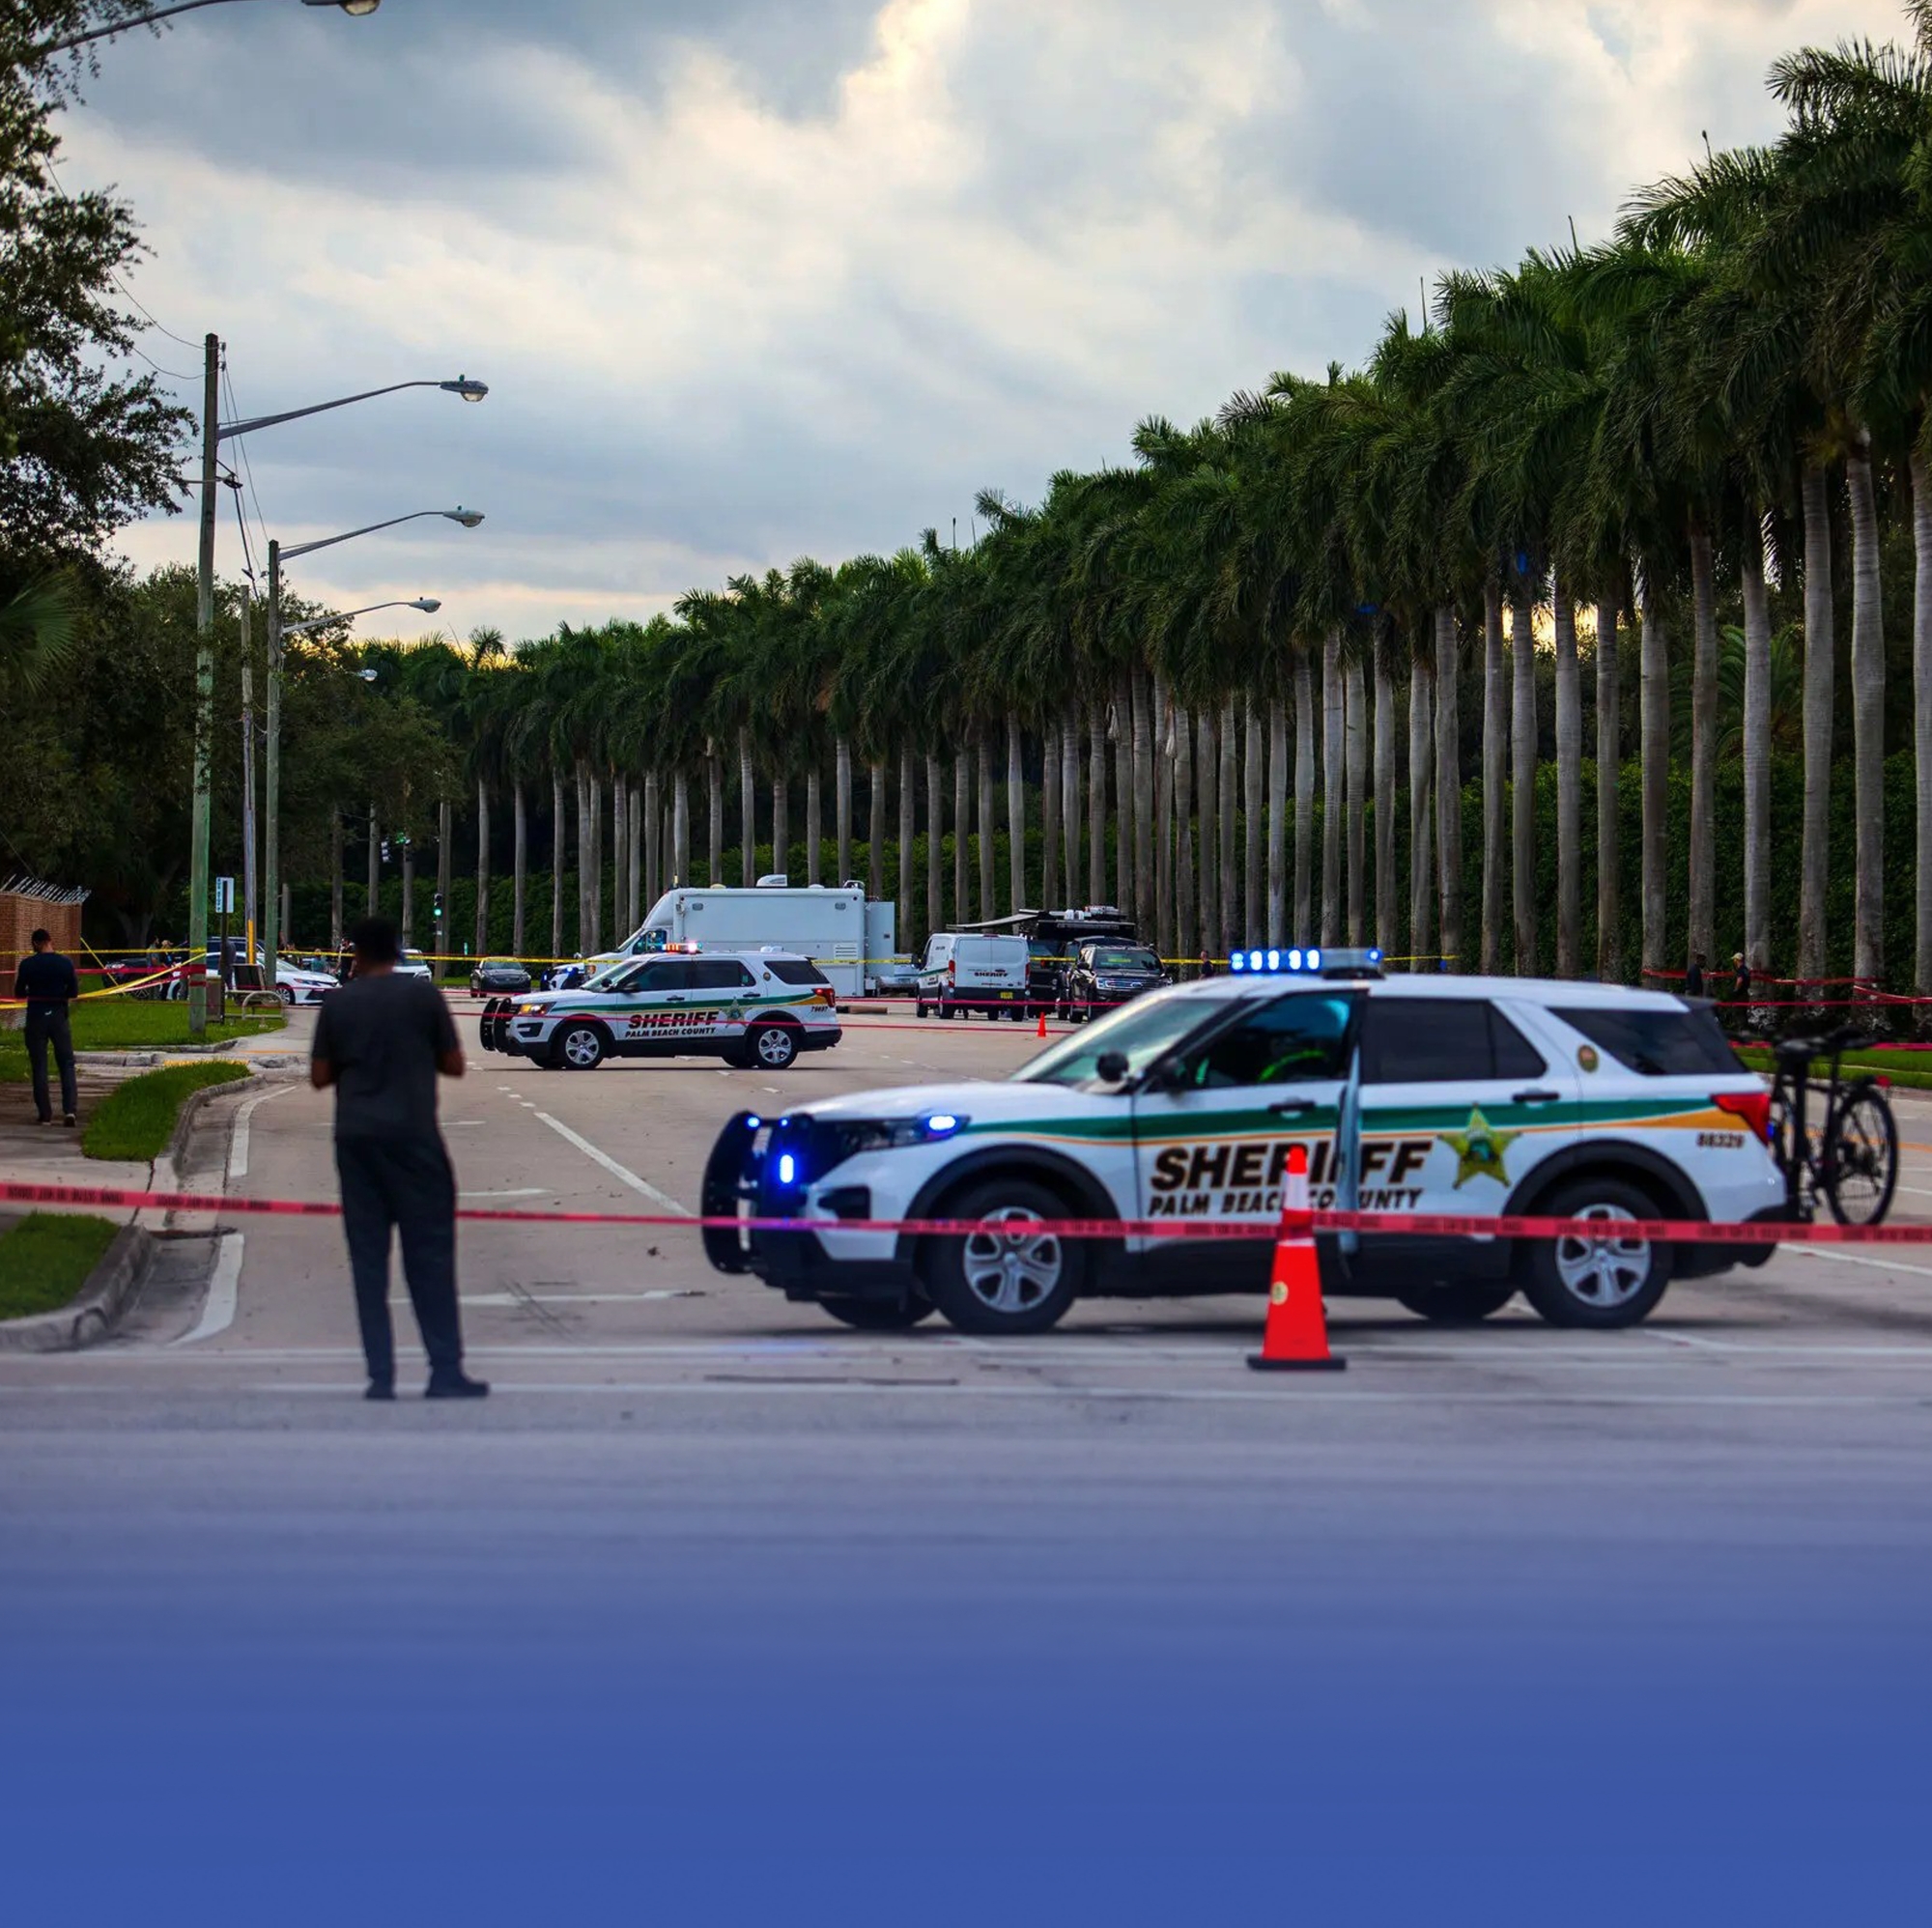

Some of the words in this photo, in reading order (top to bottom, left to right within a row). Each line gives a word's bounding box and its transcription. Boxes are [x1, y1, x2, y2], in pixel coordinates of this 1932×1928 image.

[628, 1010, 720, 1029] SHERIFF
[681, 1027, 716, 1035] COUNTY
[1148, 1192, 1209, 1217] PALM
[1221, 1190, 1286, 1214] BEAC
